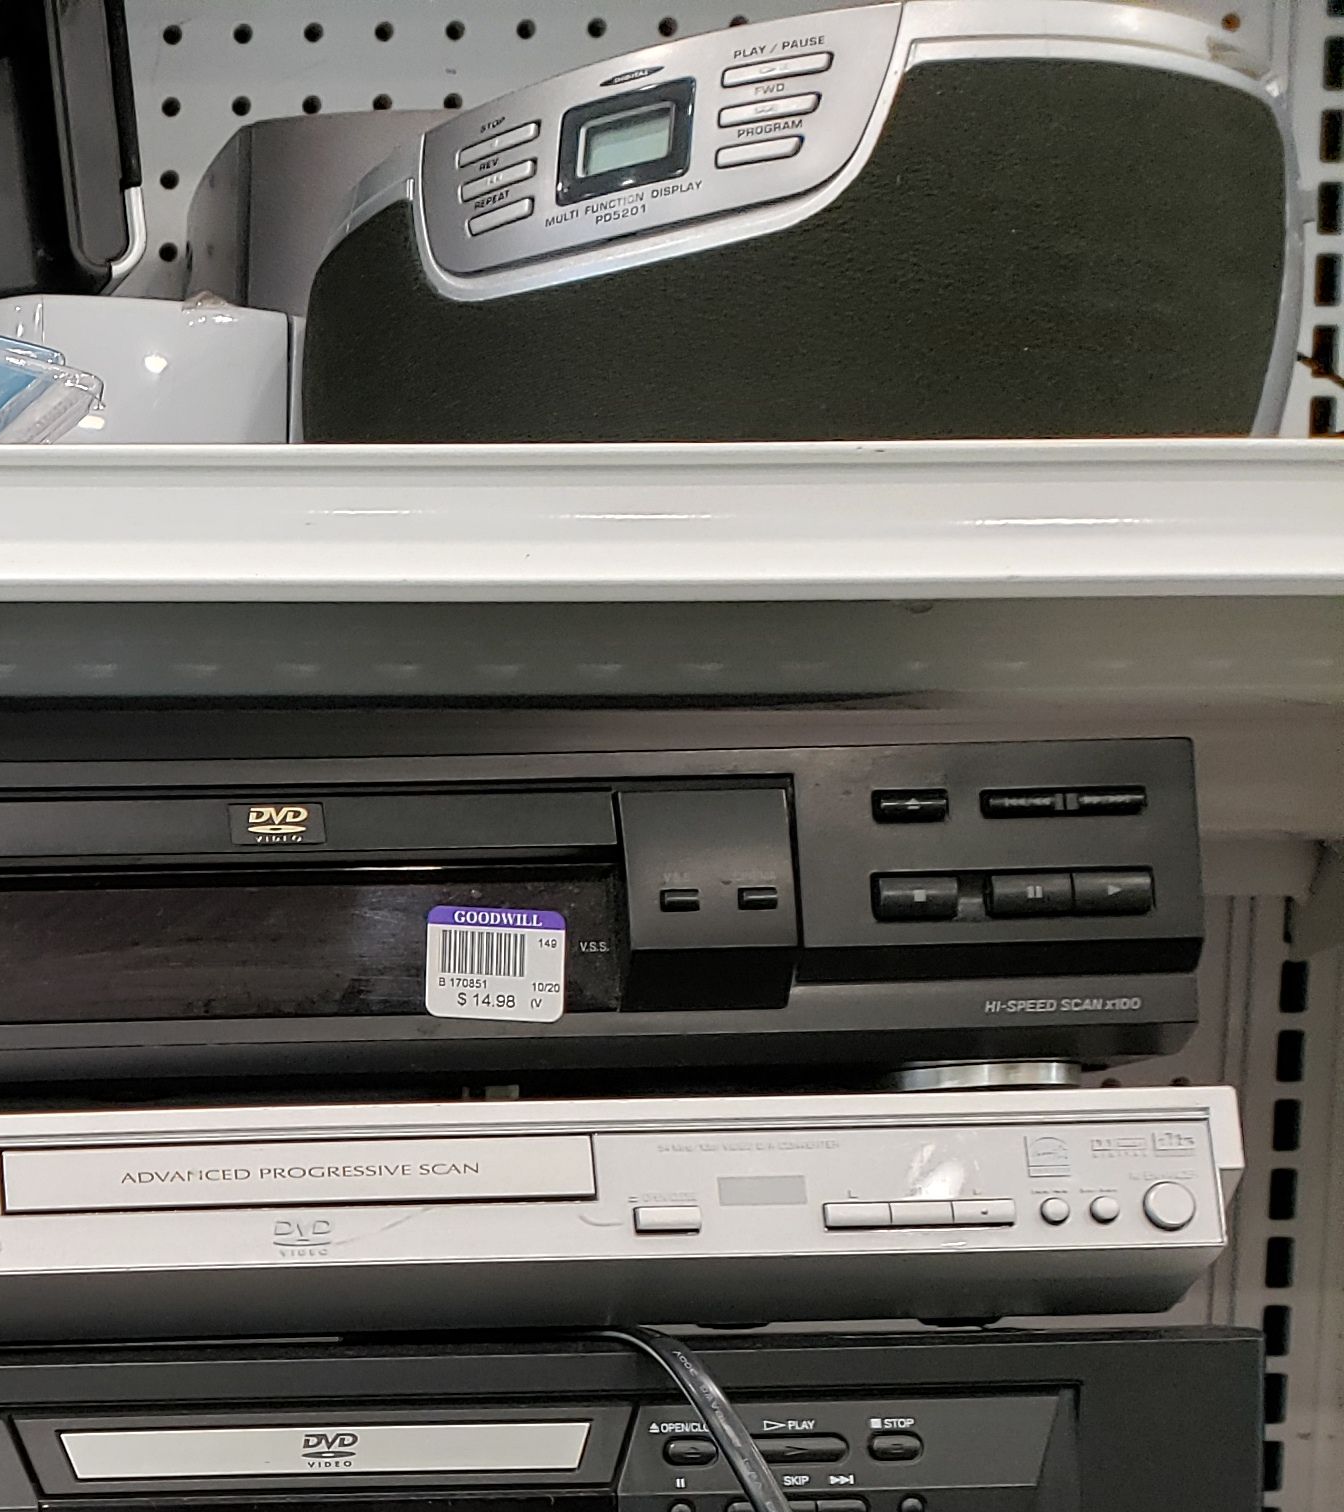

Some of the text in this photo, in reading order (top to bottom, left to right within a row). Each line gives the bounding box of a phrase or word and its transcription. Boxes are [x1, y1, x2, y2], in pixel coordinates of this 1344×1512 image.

[733, 35, 825, 59] PLAY PAUSE
[754, 83, 785, 96] FWD
[737, 119, 803, 138] PROGRAM
[474, 190, 510, 210] REPEAT
[545, 180, 703, 227] MULTI FUNCTION DISPLAY
[595, 204, 648, 225] PD5201
[453, 911, 543, 927] GOODWILL
[538, 939, 557, 948] 149
[450, 977, 560, 993] 170851 10/20
[472, 993, 516, 1008] 14.98
[984, 997, 1142, 1013] HI-SPEED SCAN x100
[121, 1162, 480, 1184] ADVANCED PROGRESSIVE SCAN
[788, 1420, 815, 1430] PLAY
[884, 1418, 914, 1428] STOP
[303, 1433, 358, 1450] DVD
[783, 1475, 809, 1486] SKIP
